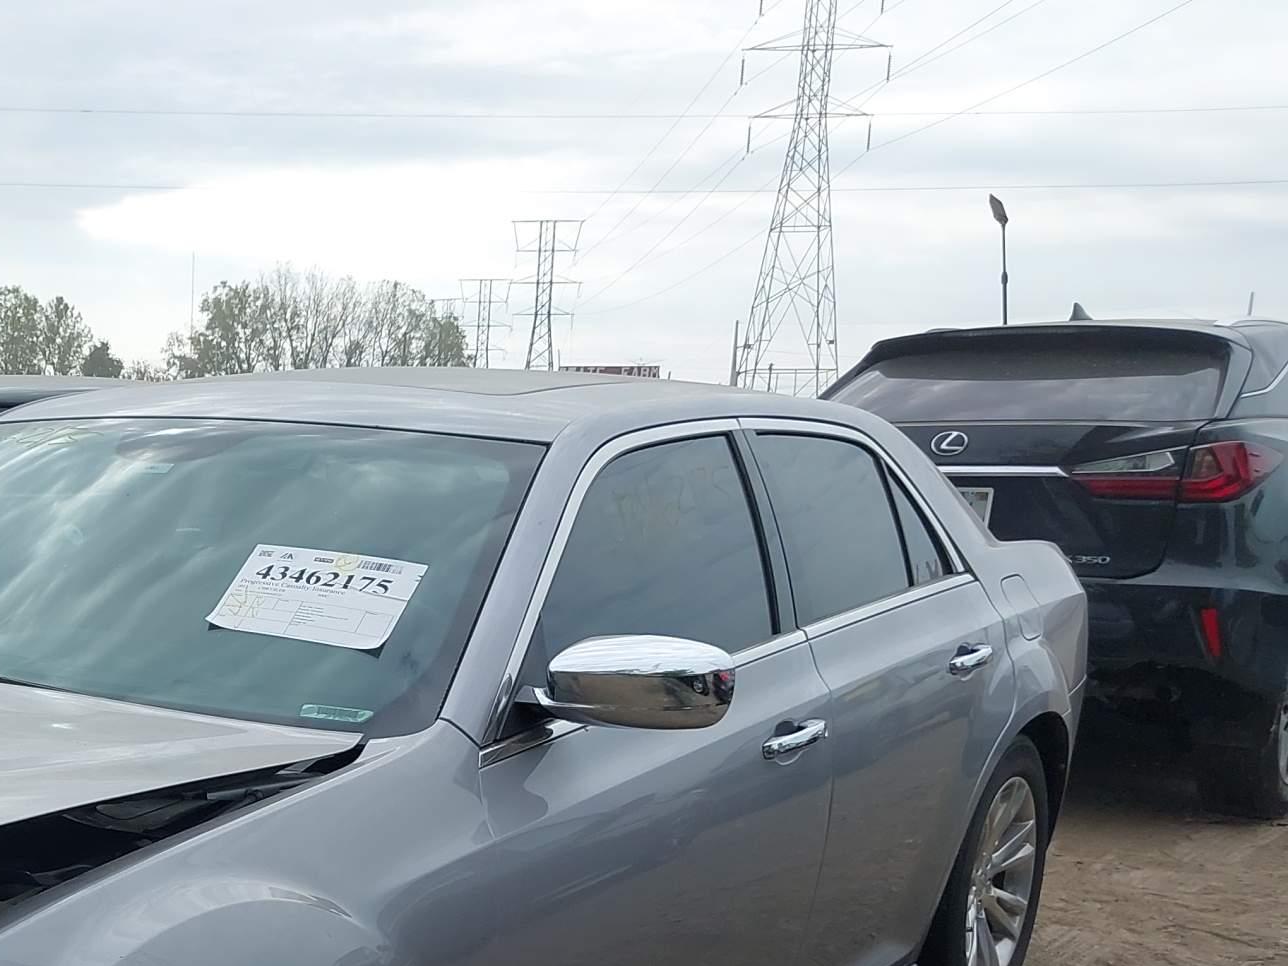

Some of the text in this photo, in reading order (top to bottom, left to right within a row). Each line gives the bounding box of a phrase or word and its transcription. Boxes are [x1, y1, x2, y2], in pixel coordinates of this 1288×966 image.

[1075, 555, 1111, 564] 350
[256, 564, 394, 595] 43462175
[312, 585, 346, 596] Insurance
